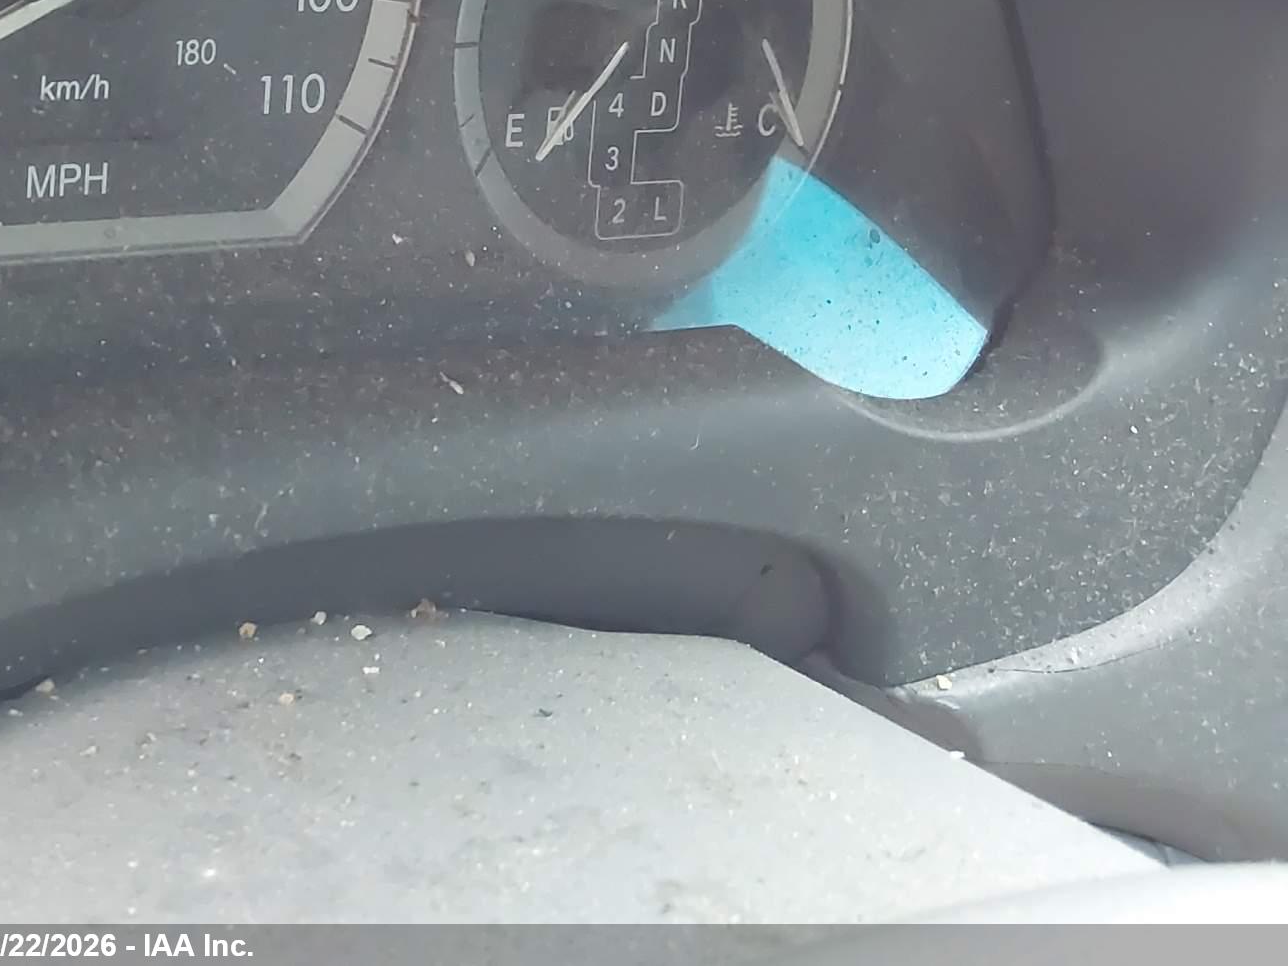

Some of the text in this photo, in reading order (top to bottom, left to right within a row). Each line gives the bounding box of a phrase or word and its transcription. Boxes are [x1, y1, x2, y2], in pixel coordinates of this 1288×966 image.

[175, 39, 217, 65] 180
[659, 38, 676, 63] N
[40, 75, 110, 102] km/h
[260, 73, 325, 115] 110
[609, 92, 667, 116] 4 D
[505, 114, 524, 147] E
[758, 104, 778, 136] C
[606, 147, 619, 170] 3
[26, 162, 109, 199] MPH
[612, 197, 668, 223] 2 L
